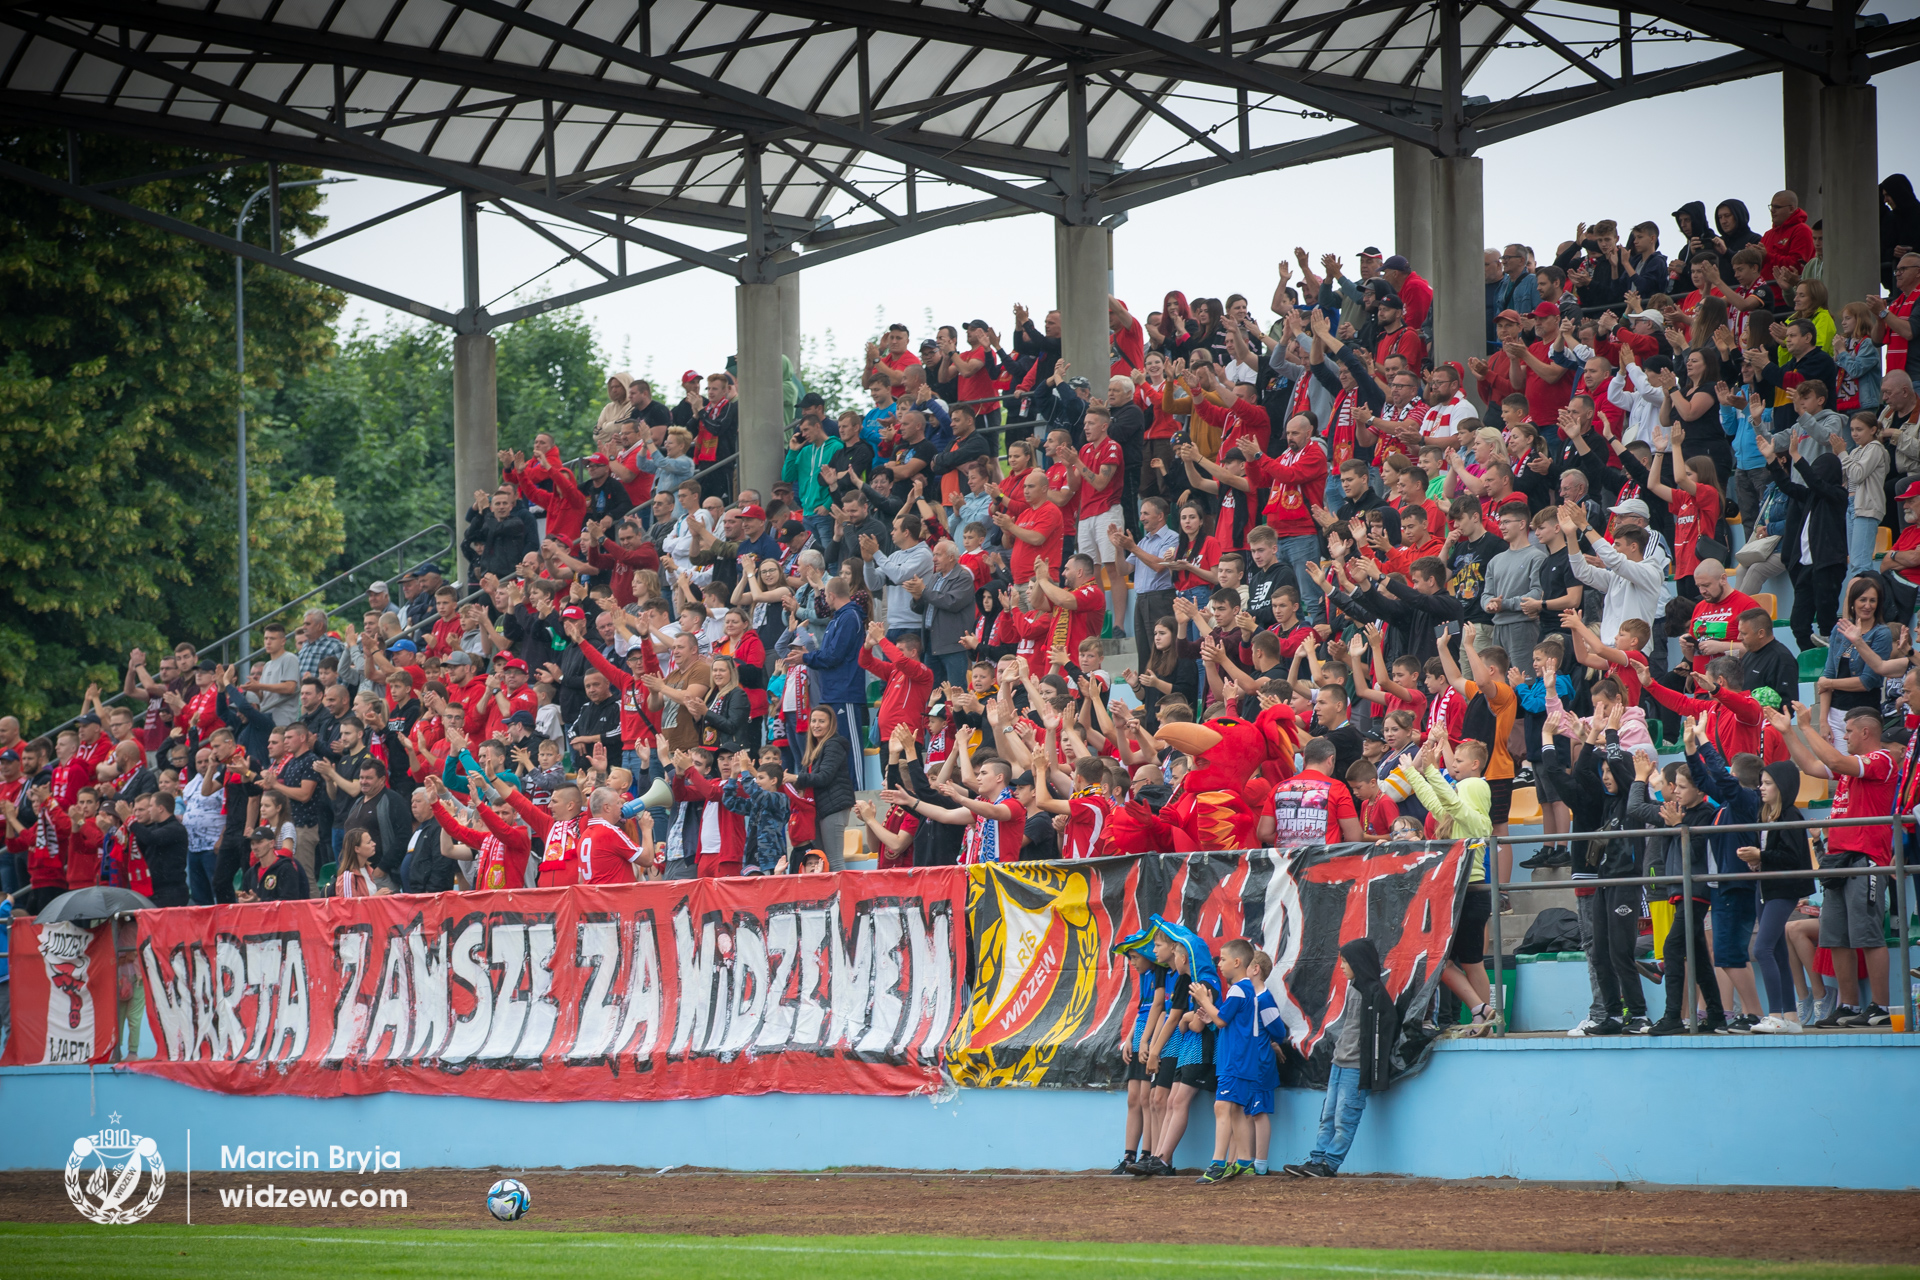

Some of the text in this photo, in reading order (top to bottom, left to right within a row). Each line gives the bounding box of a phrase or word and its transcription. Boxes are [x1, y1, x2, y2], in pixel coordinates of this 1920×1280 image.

[580, 838, 592, 880] 9
[1017, 930, 1038, 968] RTS
[141, 930, 311, 1063] WARTA
[326, 911, 559, 1073] ZAWSZE
[563, 909, 662, 1074] ZA
[1000, 945, 1057, 1031] WIDZEW
